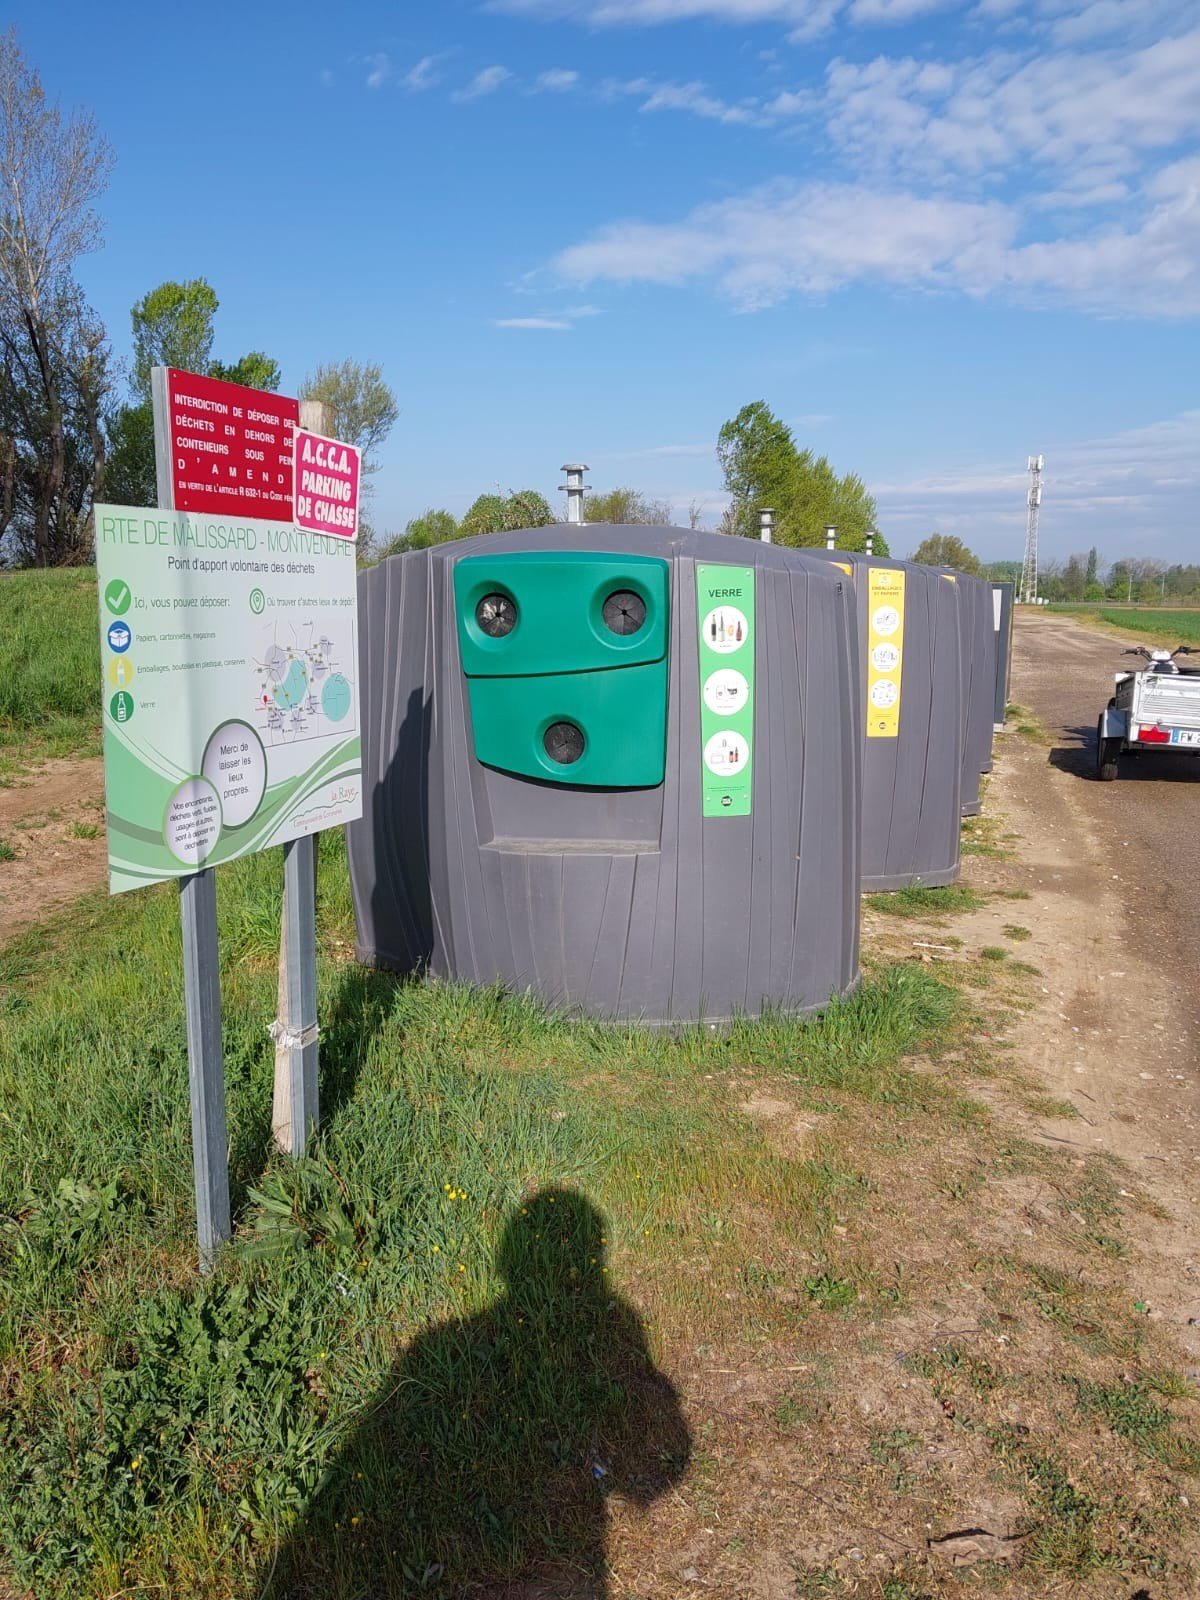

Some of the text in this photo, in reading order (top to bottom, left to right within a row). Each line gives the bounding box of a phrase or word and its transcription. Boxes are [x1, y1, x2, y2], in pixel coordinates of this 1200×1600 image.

[174, 394, 228, 415] INTERDICTION
[232, 406, 243, 418] DE
[247, 409, 279, 425] DÉPOSER
[176, 414, 293, 447] DÉCHETS EN DEHORS DE
[176, 437, 293, 466] CONTENEURS SOUS PEIN
[302, 438, 352, 475] A.C.C.A.
[179, 481, 186, 489] EN
[188, 482, 204, 491] VERTU
[205, 484, 213, 492] DE
[213, 484, 238, 496] L'ARTICLE
[239, 487, 244, 496] R
[245, 488, 261, 498] 632-1
[302, 469, 352, 502] PARKING
[297, 495, 355, 530] DE CHASSE
[102, 517, 139, 544] RTE
[144, 520, 169, 546] DE
[173, 523, 257, 550] MALISSARD
[268, 530, 352, 557] MONTVENDRE
[168, 556, 315, 575] Point d'apport volontaire des déchets
[267, 597, 276, 607] Où
[276, 598, 296, 607] trouver
[298, 597, 318, 607] d'autres
[319, 597, 330, 606] lieux
[331, 597, 338, 606] de
[708, 587, 743, 599] VERRE
[134, 596, 230, 610] Ici, vous pouvez déposer:
[220, 742, 249, 756] Merci de
[218, 756, 252, 771] laisser les
[228, 773, 244, 784] lieux
